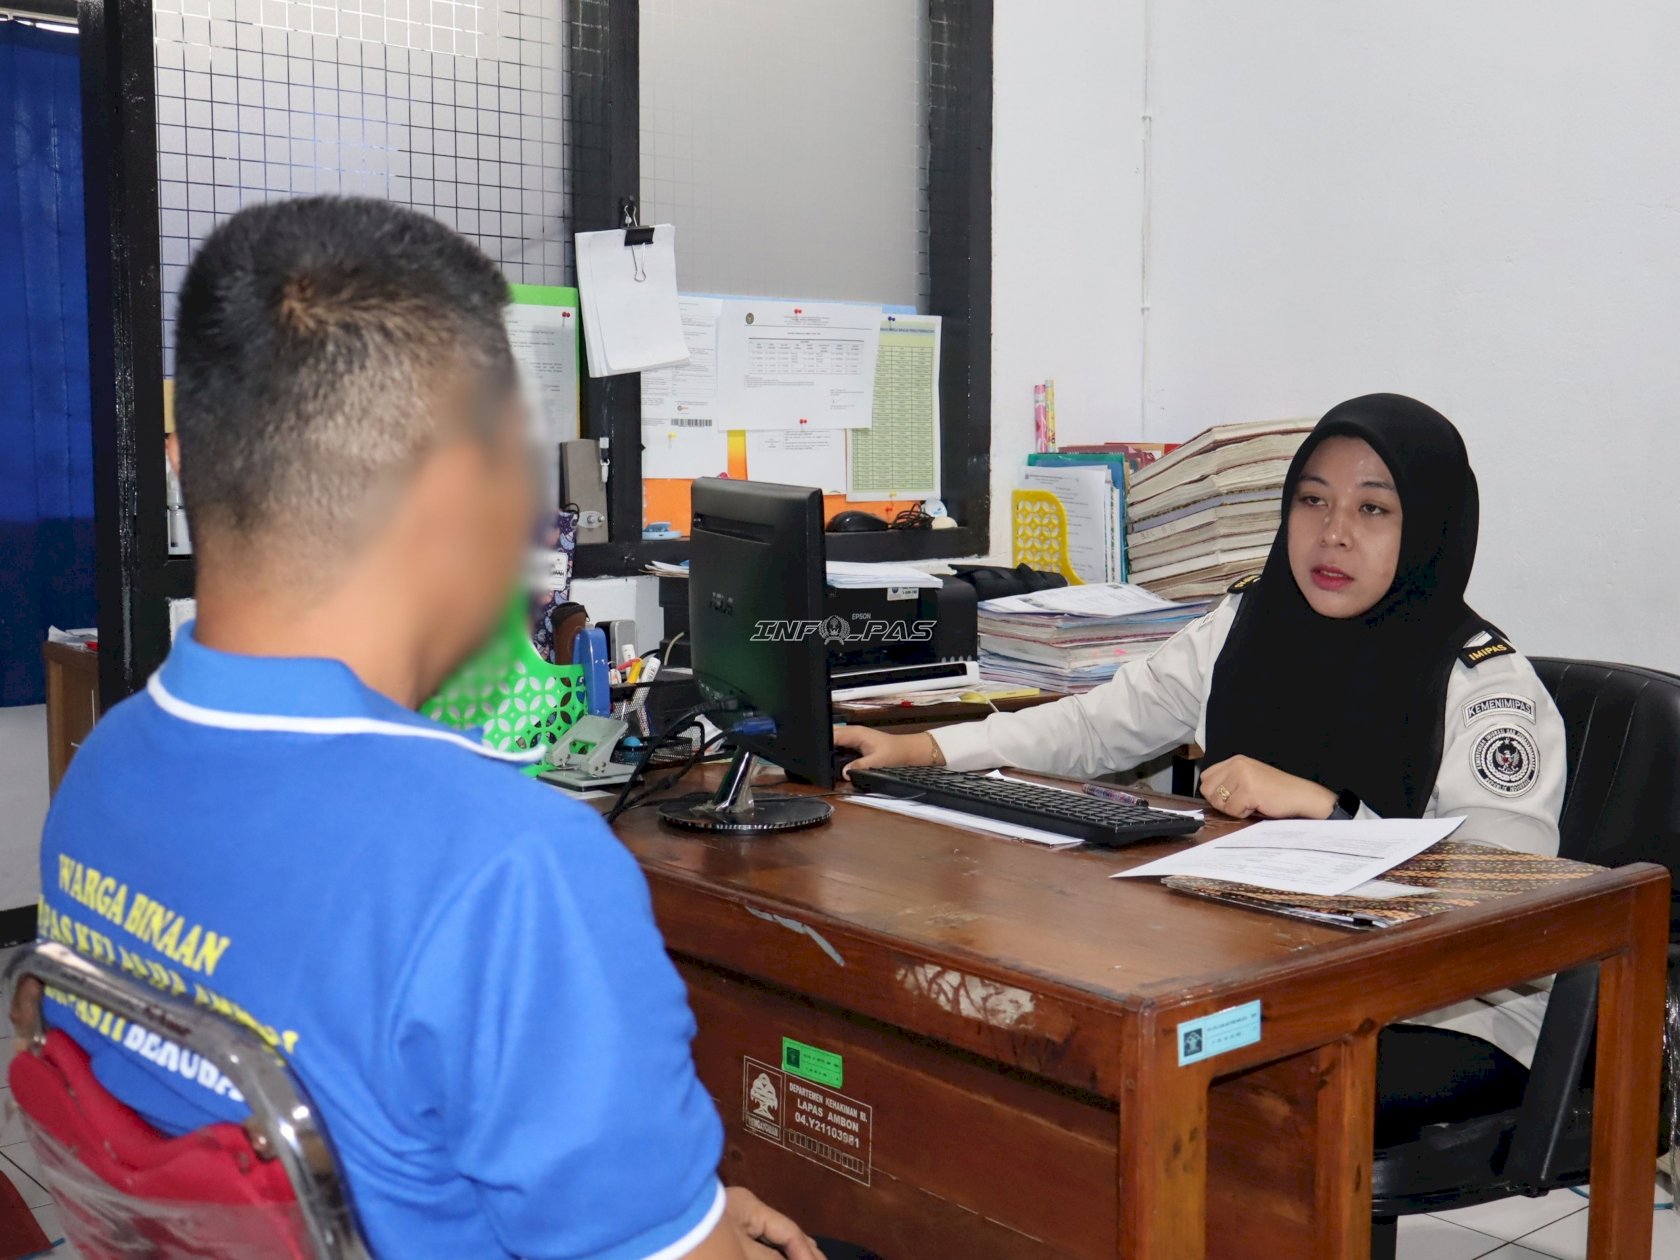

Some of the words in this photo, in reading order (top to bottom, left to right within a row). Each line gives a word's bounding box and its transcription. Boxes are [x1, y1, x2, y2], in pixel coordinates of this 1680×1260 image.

[851, 612, 872, 620] EPSON
[1468, 644, 1508, 661] IMIPAS
[1468, 698, 1532, 718] KEMENIMIPAS
[58, 852, 128, 926] WARGA
[123, 891, 232, 977] BINAAN
[789, 1082, 824, 1104] DEPARTEMEN
[825, 1097, 858, 1119] KEHAKIMAN
[797, 1098, 824, 1118] LAPAS
[827, 1111, 859, 1133] AMBON
